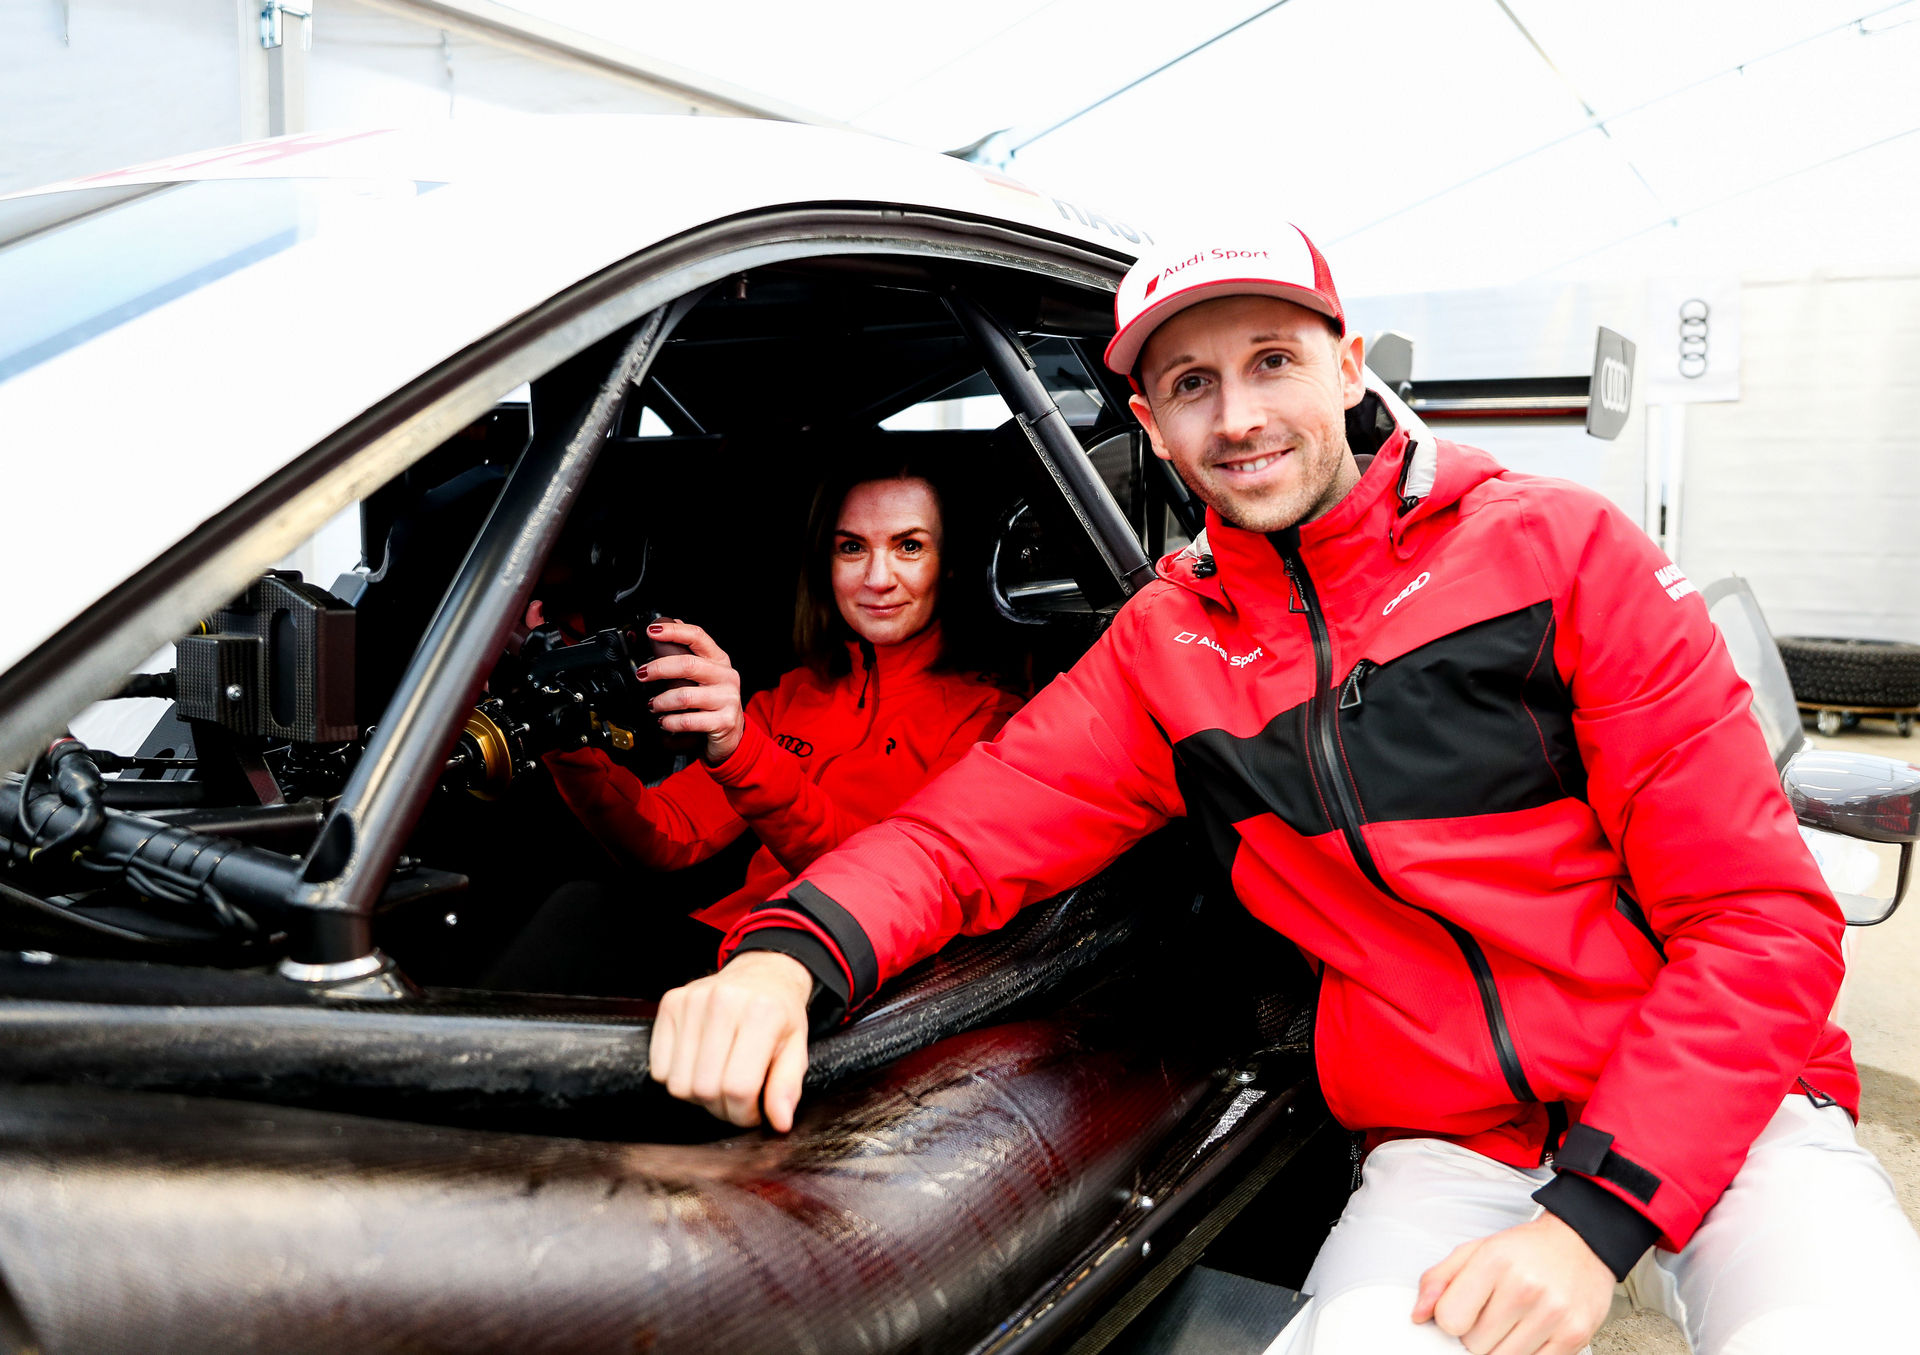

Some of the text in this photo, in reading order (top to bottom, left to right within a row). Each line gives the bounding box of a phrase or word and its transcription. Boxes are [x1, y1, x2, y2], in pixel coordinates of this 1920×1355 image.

[1163, 248, 1270, 281] Audi Sport
[1197, 636, 1264, 668] Audi Sport
